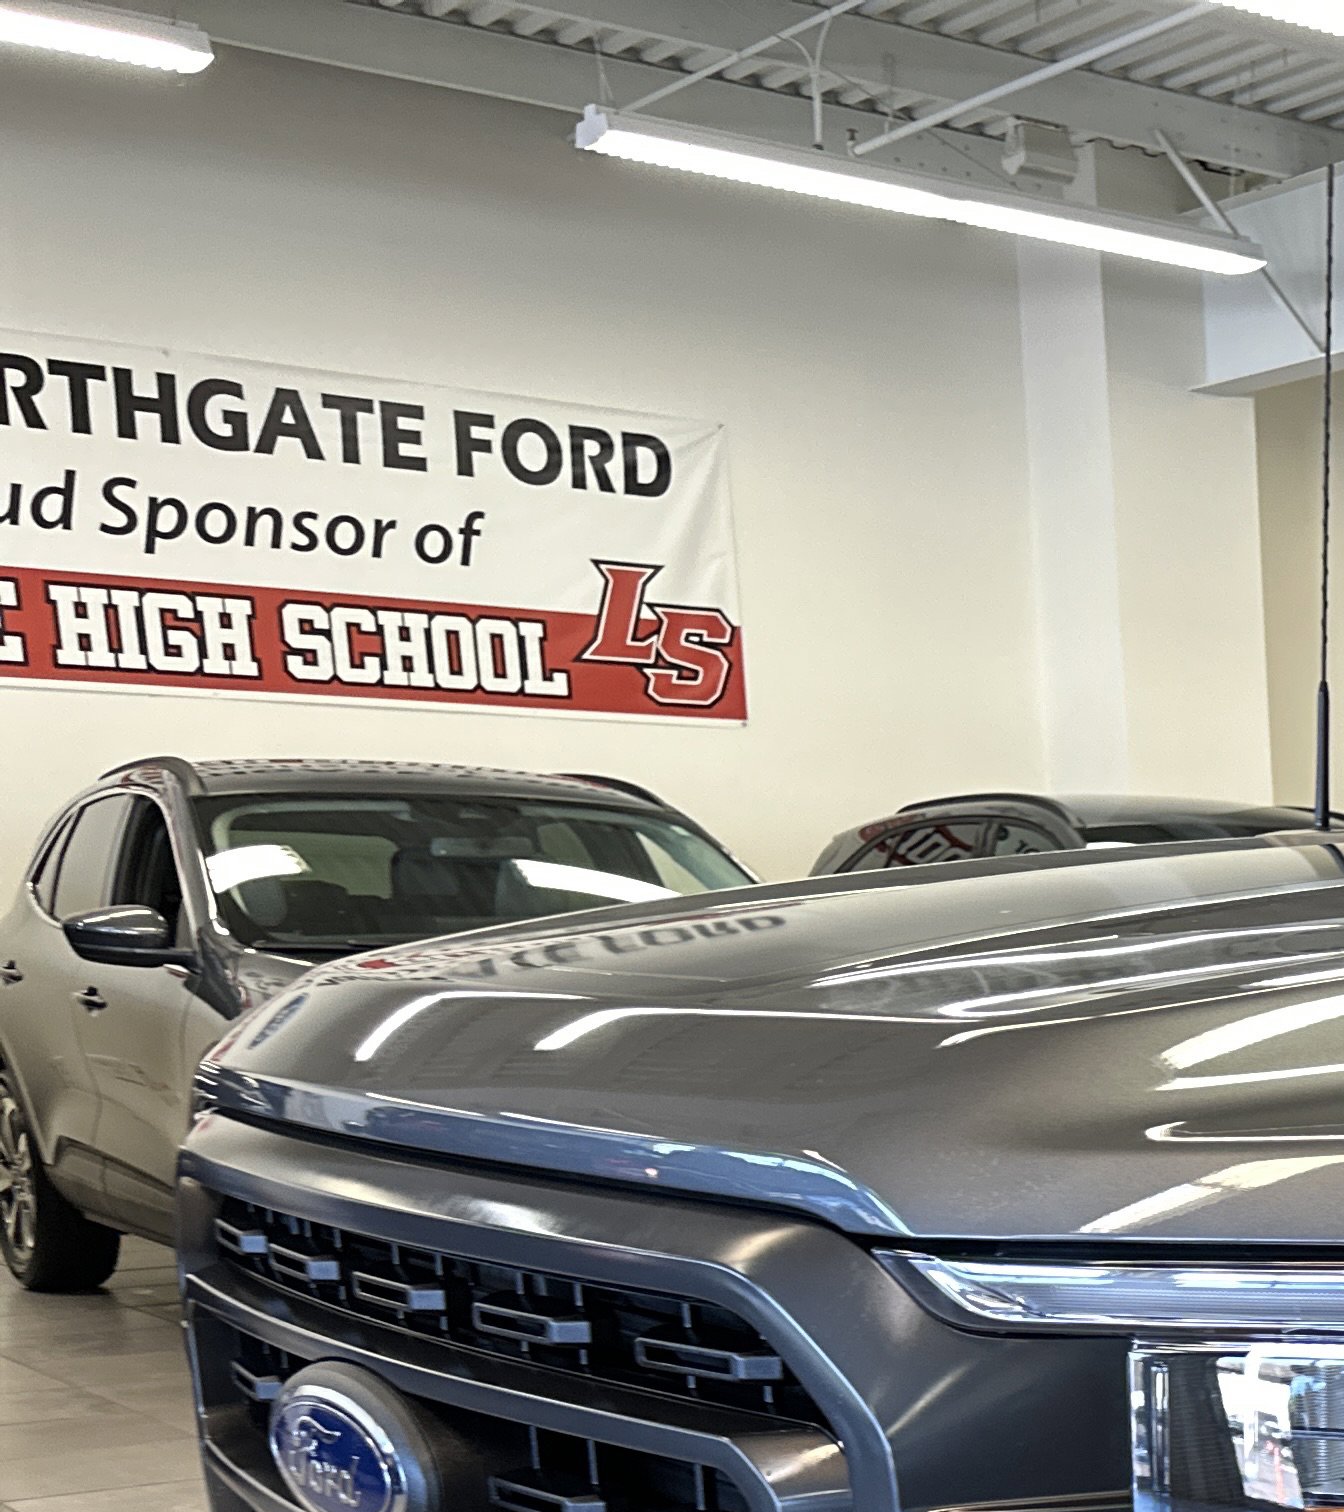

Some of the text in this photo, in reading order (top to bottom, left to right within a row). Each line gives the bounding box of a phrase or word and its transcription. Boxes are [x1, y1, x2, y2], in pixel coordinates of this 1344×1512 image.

[454, 410, 672, 498] FORD
[99, 476, 396, 558] Sponsor
[415, 511, 485, 566] of
[45, 581, 259, 678] HIGH
[279, 600, 570, 698] SCHOOL
